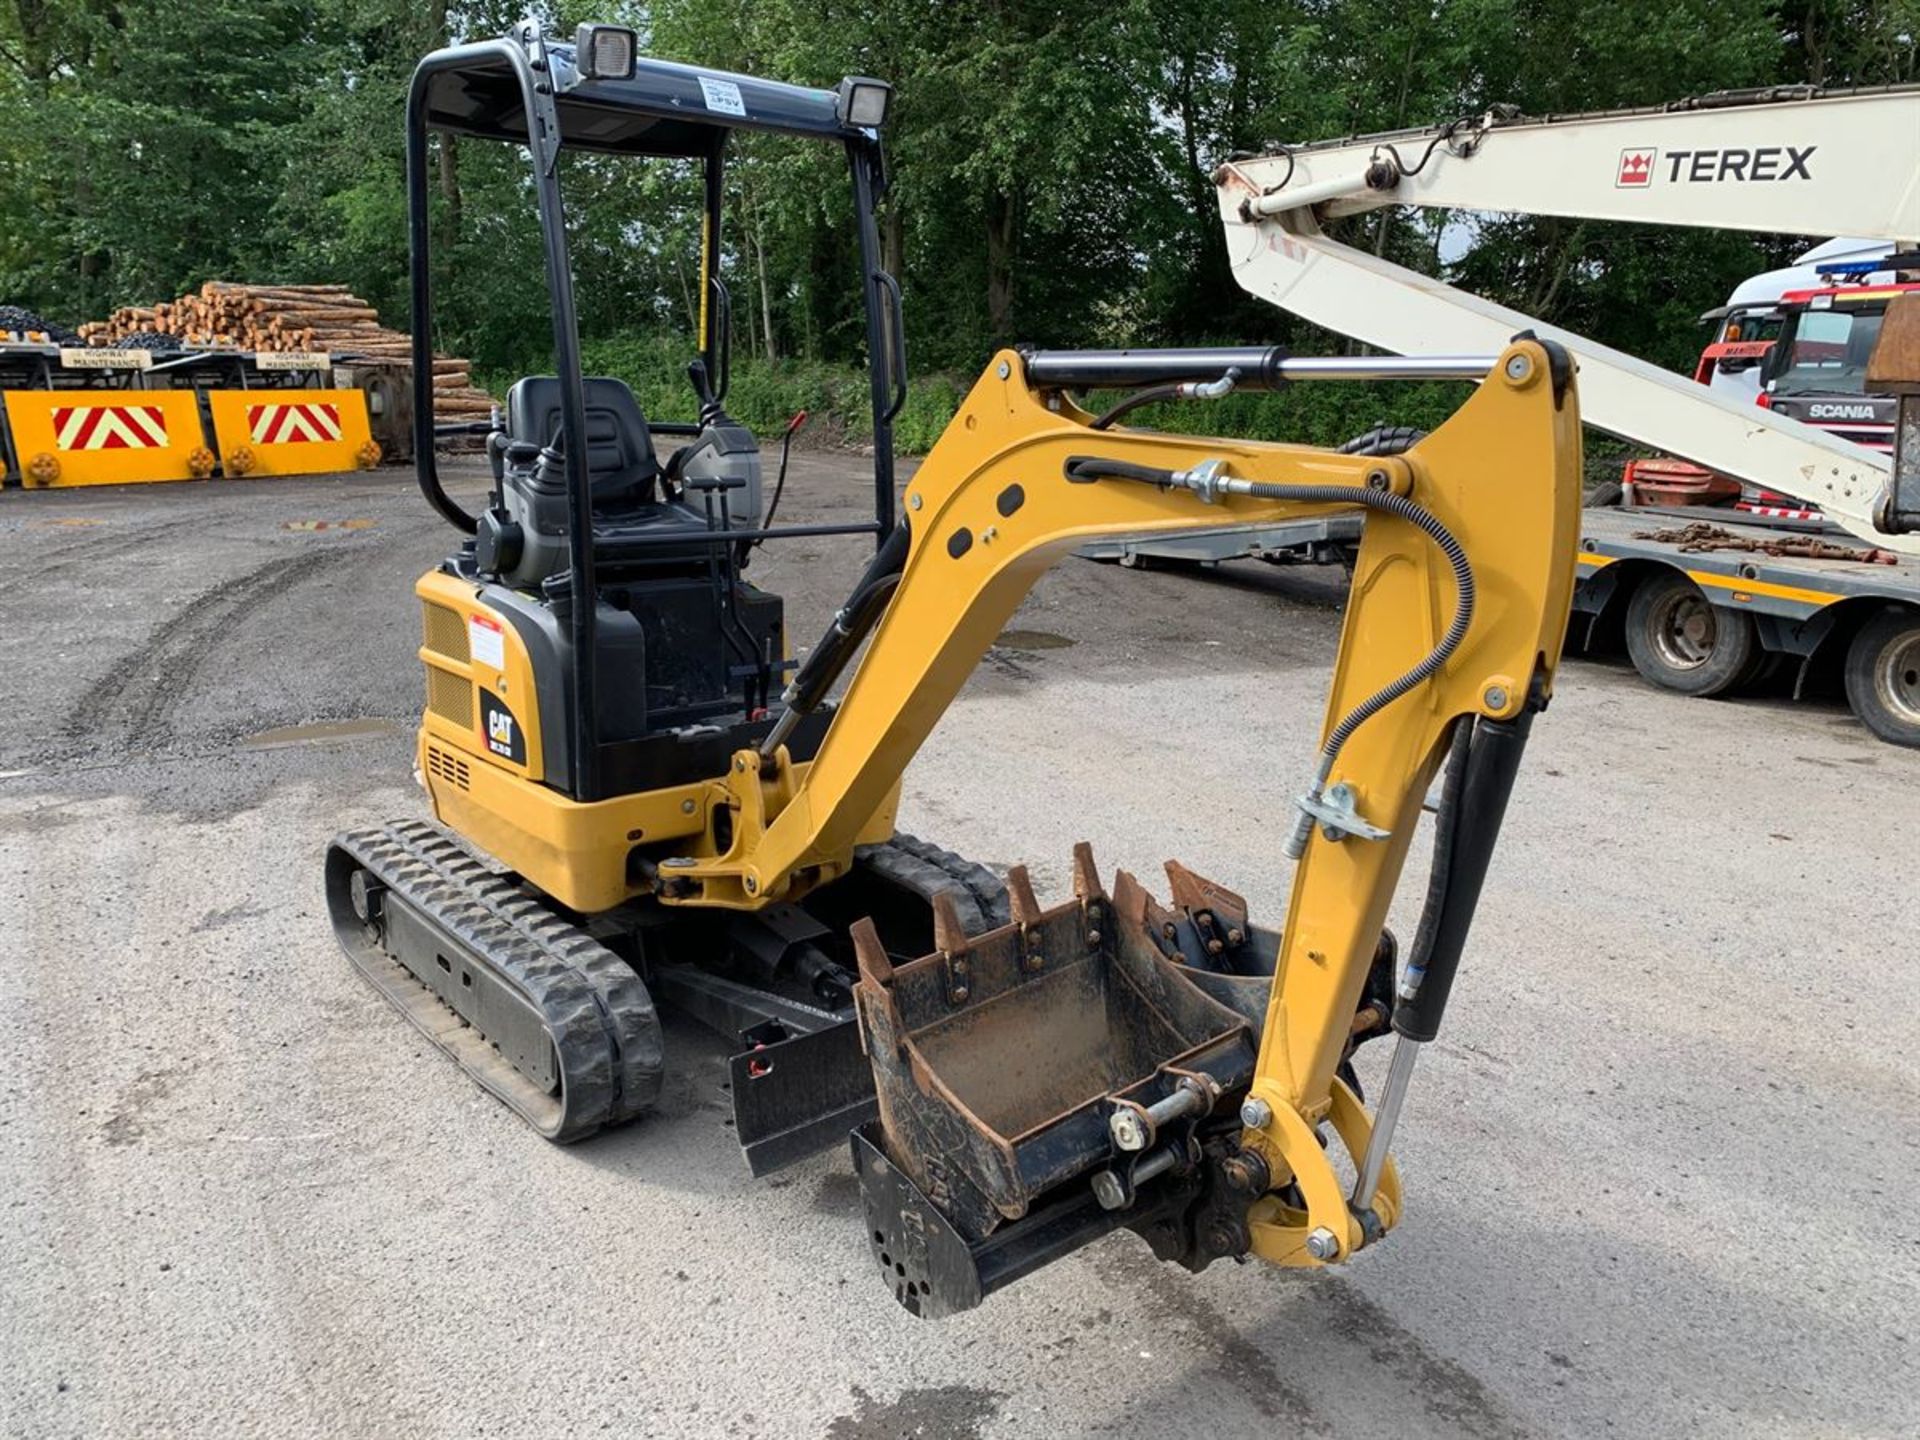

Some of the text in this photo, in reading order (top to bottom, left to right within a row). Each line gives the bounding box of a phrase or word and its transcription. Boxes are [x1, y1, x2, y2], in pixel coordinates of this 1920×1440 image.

[1665, 146, 1818, 182] TEREX
[84, 350, 128, 358] HIGHWAY
[73, 359, 141, 368] MAINTENANCE
[1809, 404, 1875, 419] SCANIA
[489, 709, 513, 746] CAT
